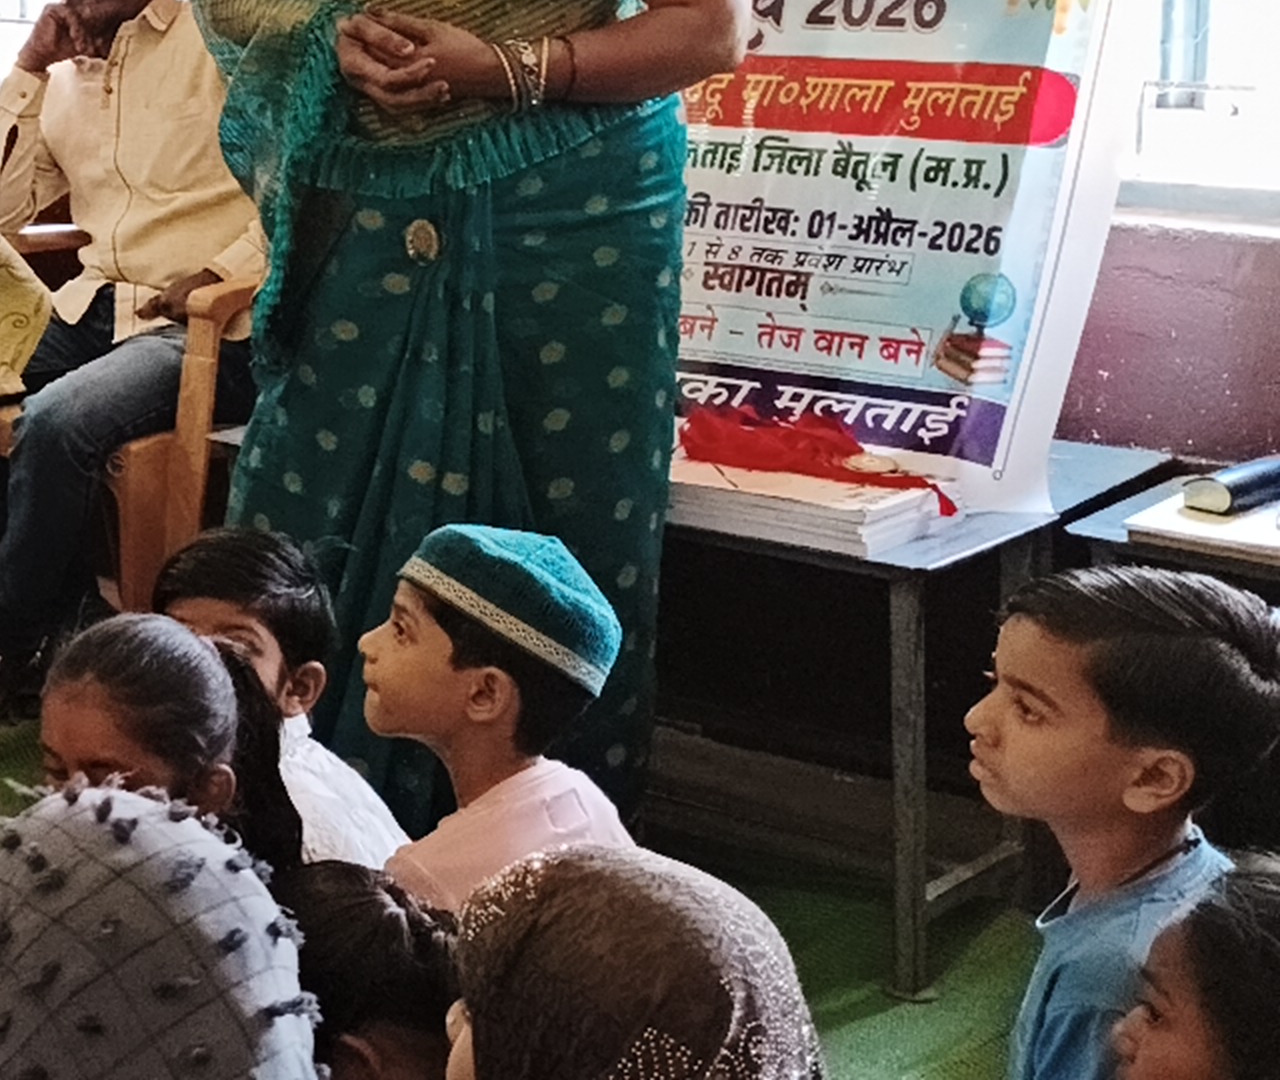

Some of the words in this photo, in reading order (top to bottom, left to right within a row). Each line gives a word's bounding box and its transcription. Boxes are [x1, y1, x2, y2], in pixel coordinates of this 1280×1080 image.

[899, 70, 1032, 132] मुलताई
[753, 134, 828, 177] जिला
[831, 140, 904, 193] बैतूल
[909, 147, 1010, 199] (म.प्र.)
[704, 235, 725, 260] से
[727, 245, 743, 261] 8
[749, 245, 789, 266] तक
[792, 245, 848, 273] प्रवेश
[849, 252, 909, 277] प्रारंभ
[701, 261, 815, 312] स्वागतम्
[757, 311, 806, 353] तेज
[813, 328, 869, 361] वान
[878, 327, 927, 368] बने
[772, 384, 970, 446] मुलताई
